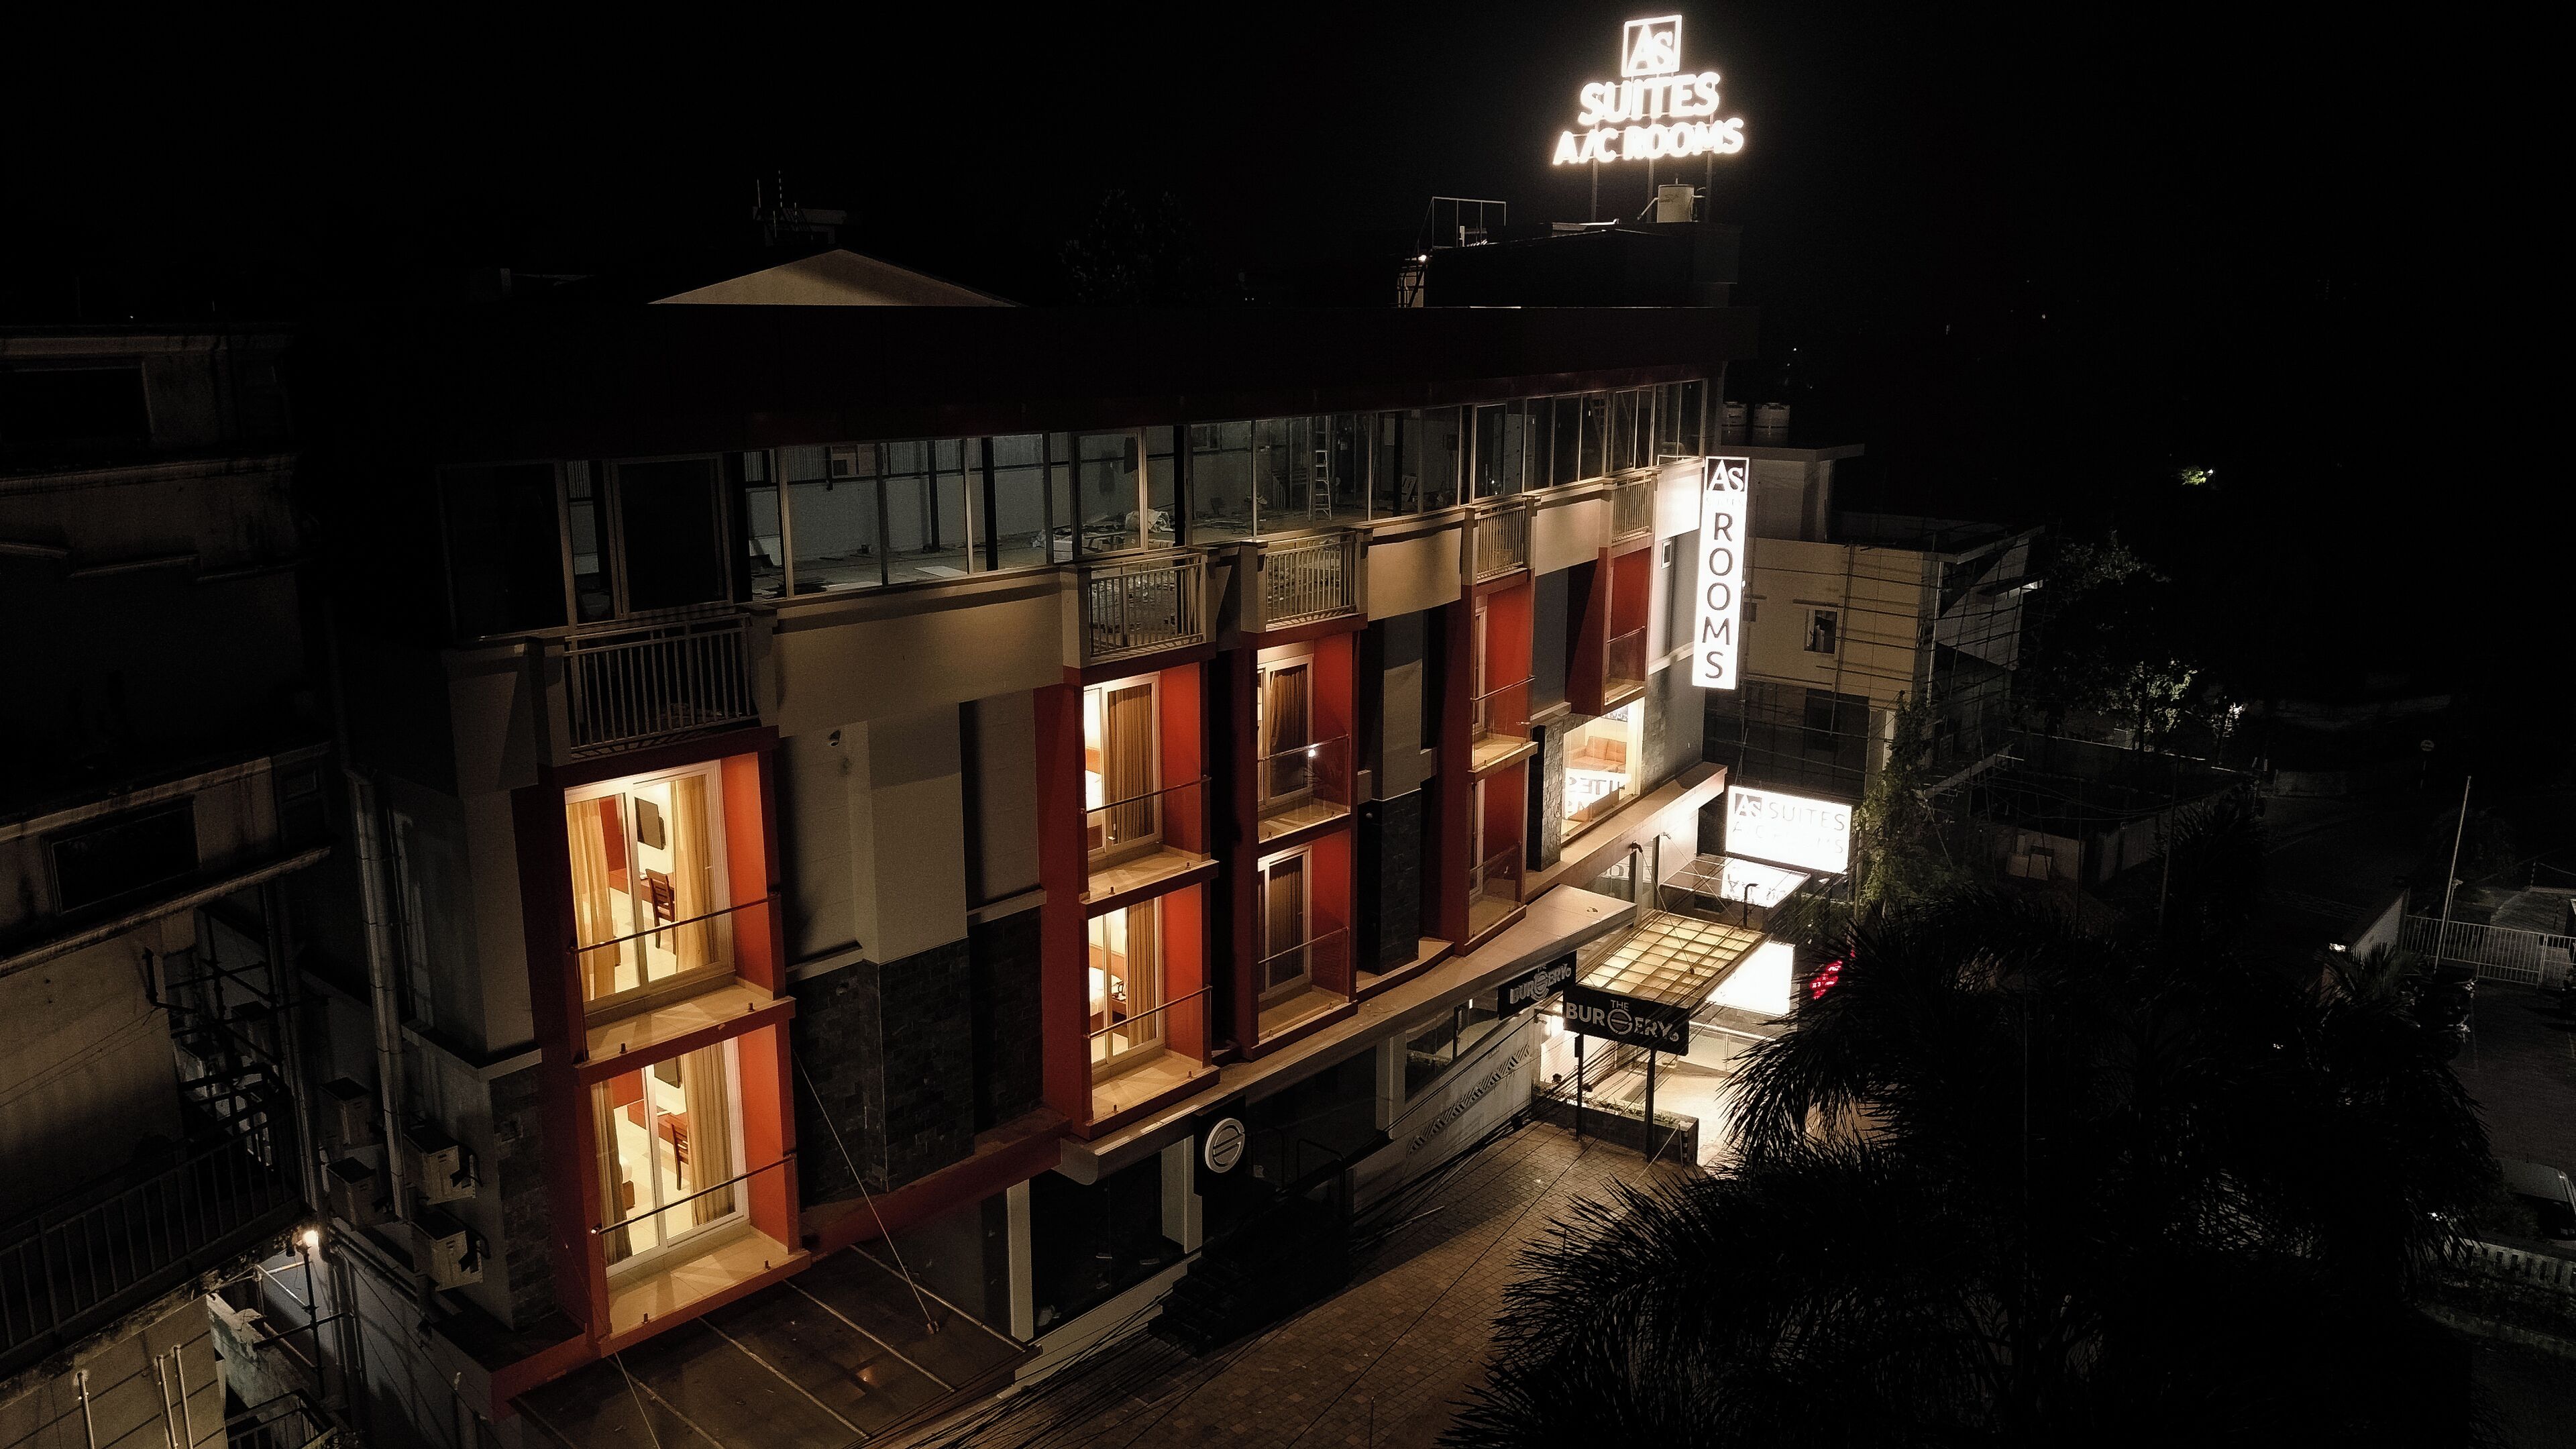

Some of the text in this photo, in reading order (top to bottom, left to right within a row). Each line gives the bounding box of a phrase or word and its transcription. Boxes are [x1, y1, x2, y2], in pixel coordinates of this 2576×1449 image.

[1626, 23, 1676, 71] AS
[1578, 72, 1721, 125] SUITES
[1553, 117, 1744, 165] A/C ROOMS
[1707, 458, 1745, 492] AS
[1702, 513, 1733, 679] ROOMS
[1769, 802, 1845, 831] SUITES
[1610, 999, 1629, 1012] THE
